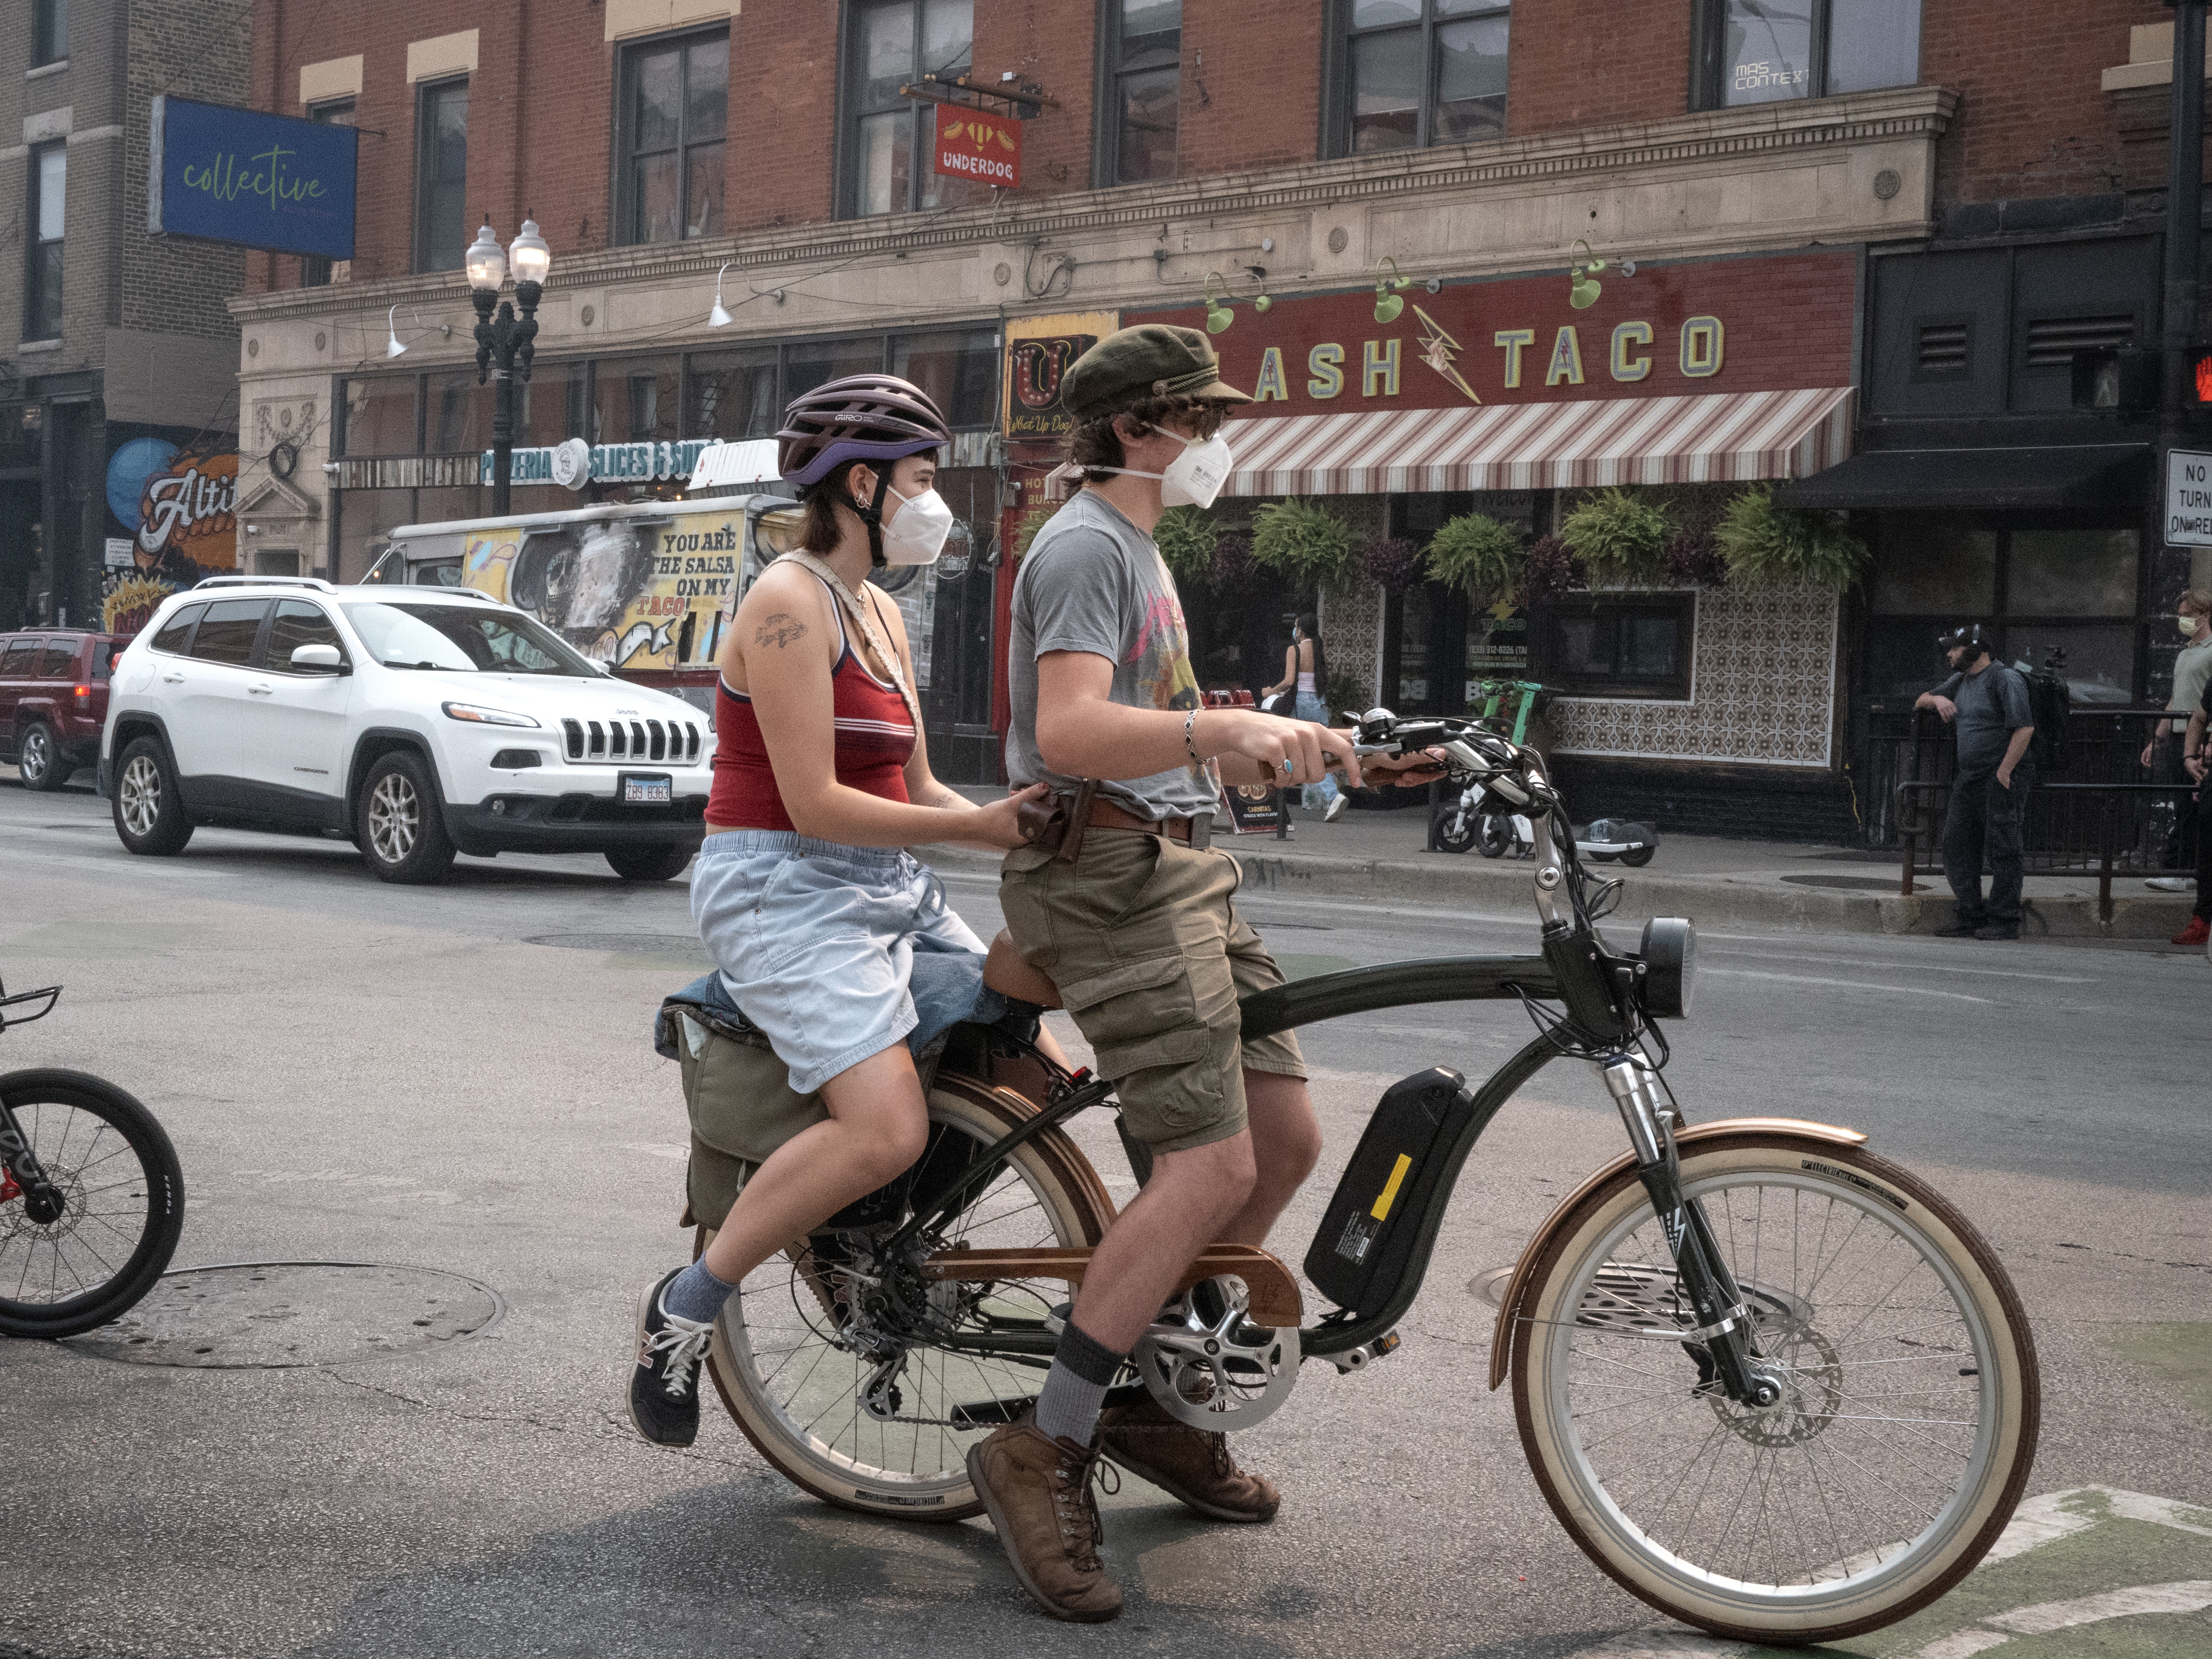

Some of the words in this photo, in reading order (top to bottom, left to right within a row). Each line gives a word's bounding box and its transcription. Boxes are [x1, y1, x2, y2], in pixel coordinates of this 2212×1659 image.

[1736, 61, 1769, 77] MAS
[943, 152, 1013, 180] UNDERDOG
[184, 145, 327, 210] collective
[1495, 315, 1725, 388] TACO
[1009, 415, 1035, 432] What
[1036, 415, 1049, 434] Up
[588, 444, 648, 478] SLICES
[653, 444, 666, 475] &
[2186, 465, 2206, 482] NO
[2180, 490, 2212, 509] TURN
[2171, 515, 2187, 533] ON
[2195, 517, 2212, 534] RE
[664, 534, 698, 553] YOU
[702, 531, 736, 551] ARE
[651, 556, 681, 575] THE
[684, 556, 735, 574] SALSA
[676, 578, 702, 596] ON
[704, 578, 731, 596] MY
[636, 596, 691, 617] TACO!
[648, 785, 668, 799] 8383
[1811, 1162, 1839, 1177] ELECTRIC
[163, 1175, 172, 1215] KENDA
